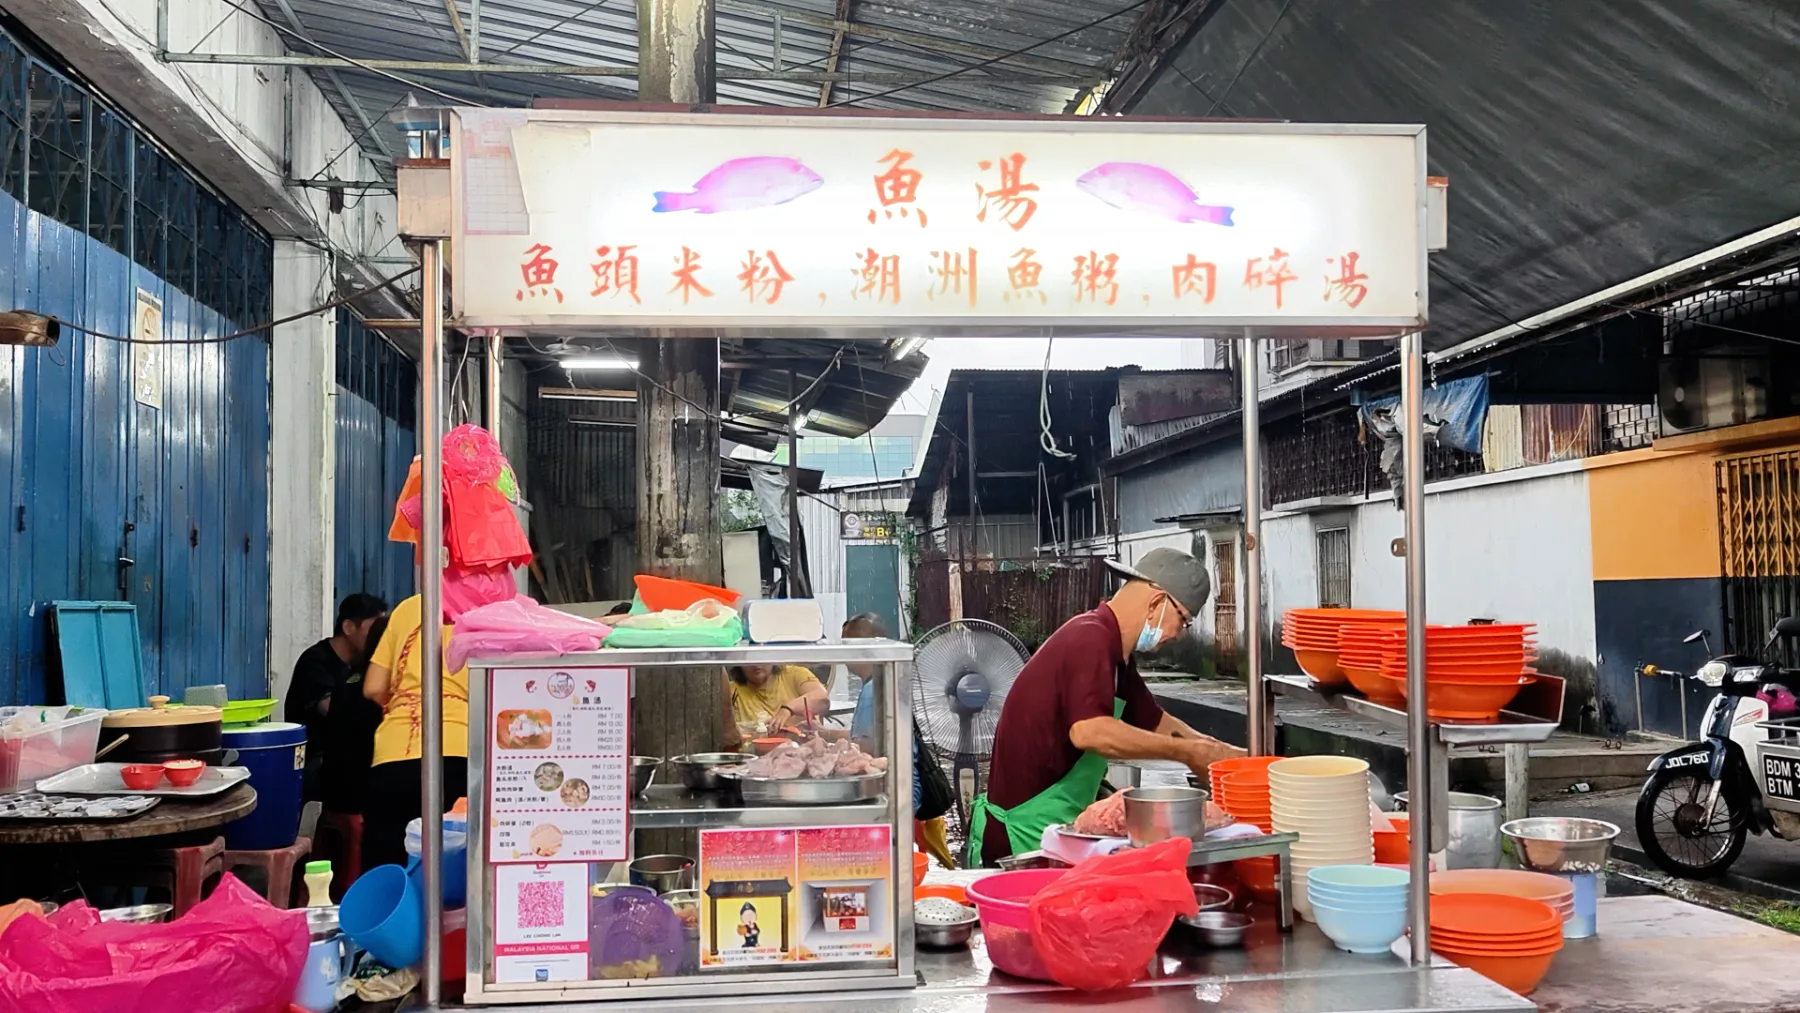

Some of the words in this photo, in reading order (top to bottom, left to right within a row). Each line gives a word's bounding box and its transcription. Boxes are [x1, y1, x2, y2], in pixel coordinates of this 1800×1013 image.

[867, 148, 1040, 232] 魚湯
[1765, 758, 1792, 777] BDM
[1767, 777, 1794, 796] BTM
[503, 944, 534, 953] MALAYSIA
[536, 943, 569, 952] NATIONAL
